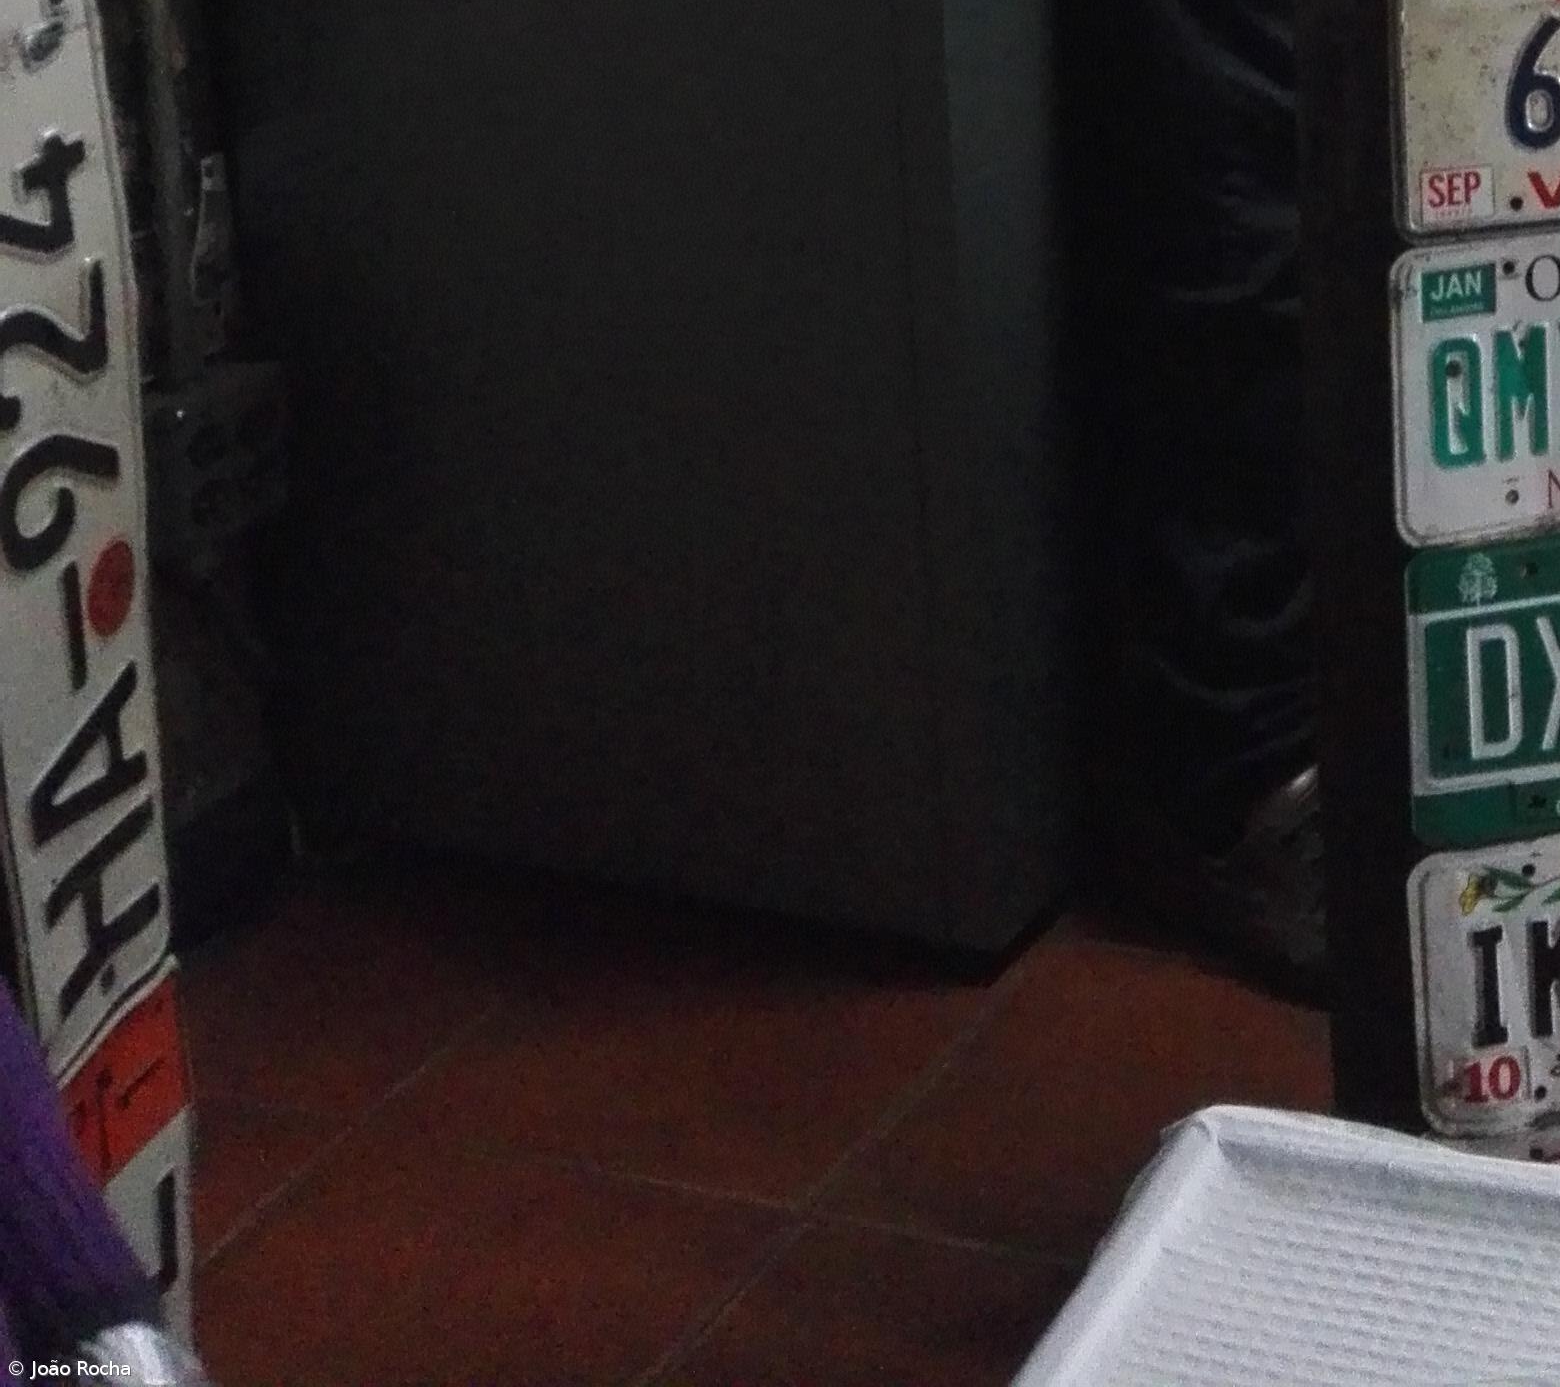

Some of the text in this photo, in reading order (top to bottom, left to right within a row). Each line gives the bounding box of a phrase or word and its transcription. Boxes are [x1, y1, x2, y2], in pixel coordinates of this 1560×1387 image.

[1427, 171, 1482, 208] SEP
[1429, 271, 1483, 302] JAN
[1463, 1055, 1522, 1104] 10
